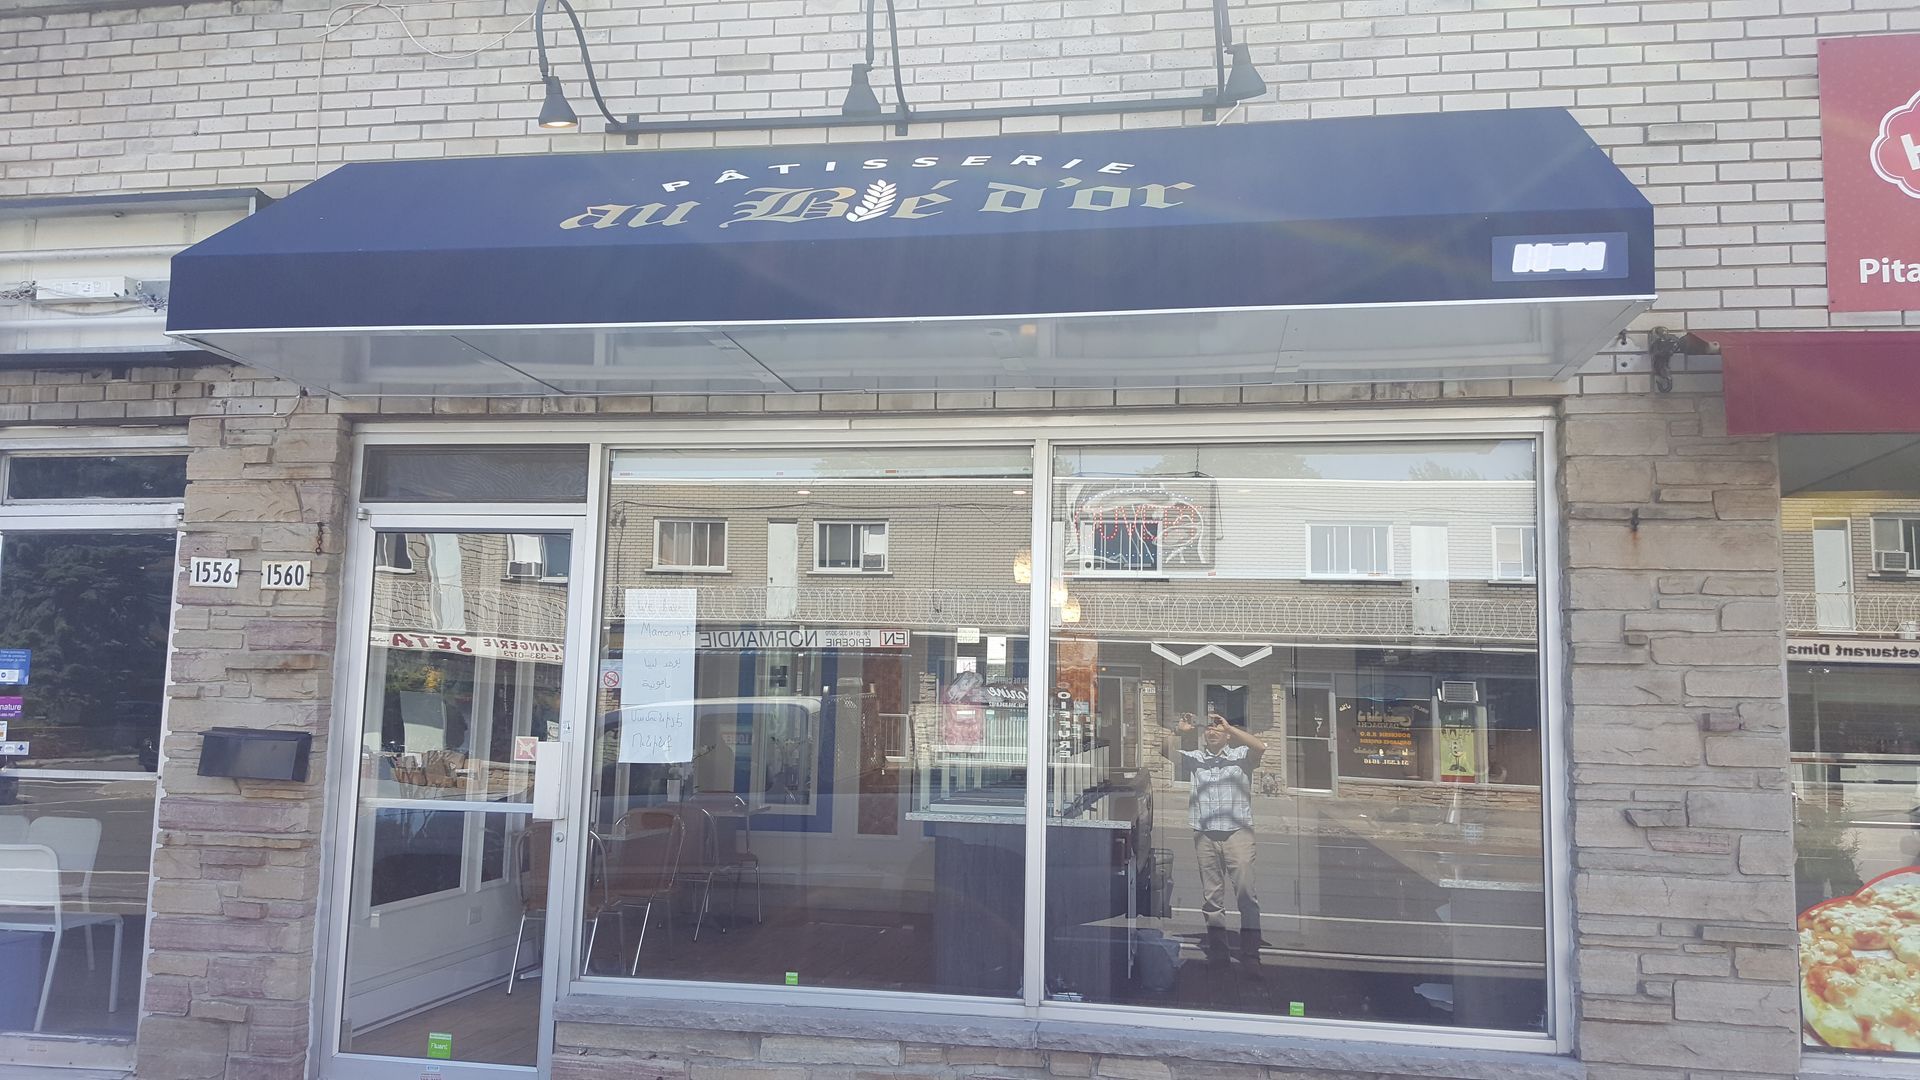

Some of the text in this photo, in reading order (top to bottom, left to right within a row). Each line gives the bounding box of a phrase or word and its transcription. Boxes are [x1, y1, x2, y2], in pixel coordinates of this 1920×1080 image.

[662, 154, 1136, 193] PÂTISSERIE
[559, 199, 701, 230] au
[195, 561, 234, 584] 1556
[266, 564, 305, 586] 1560
